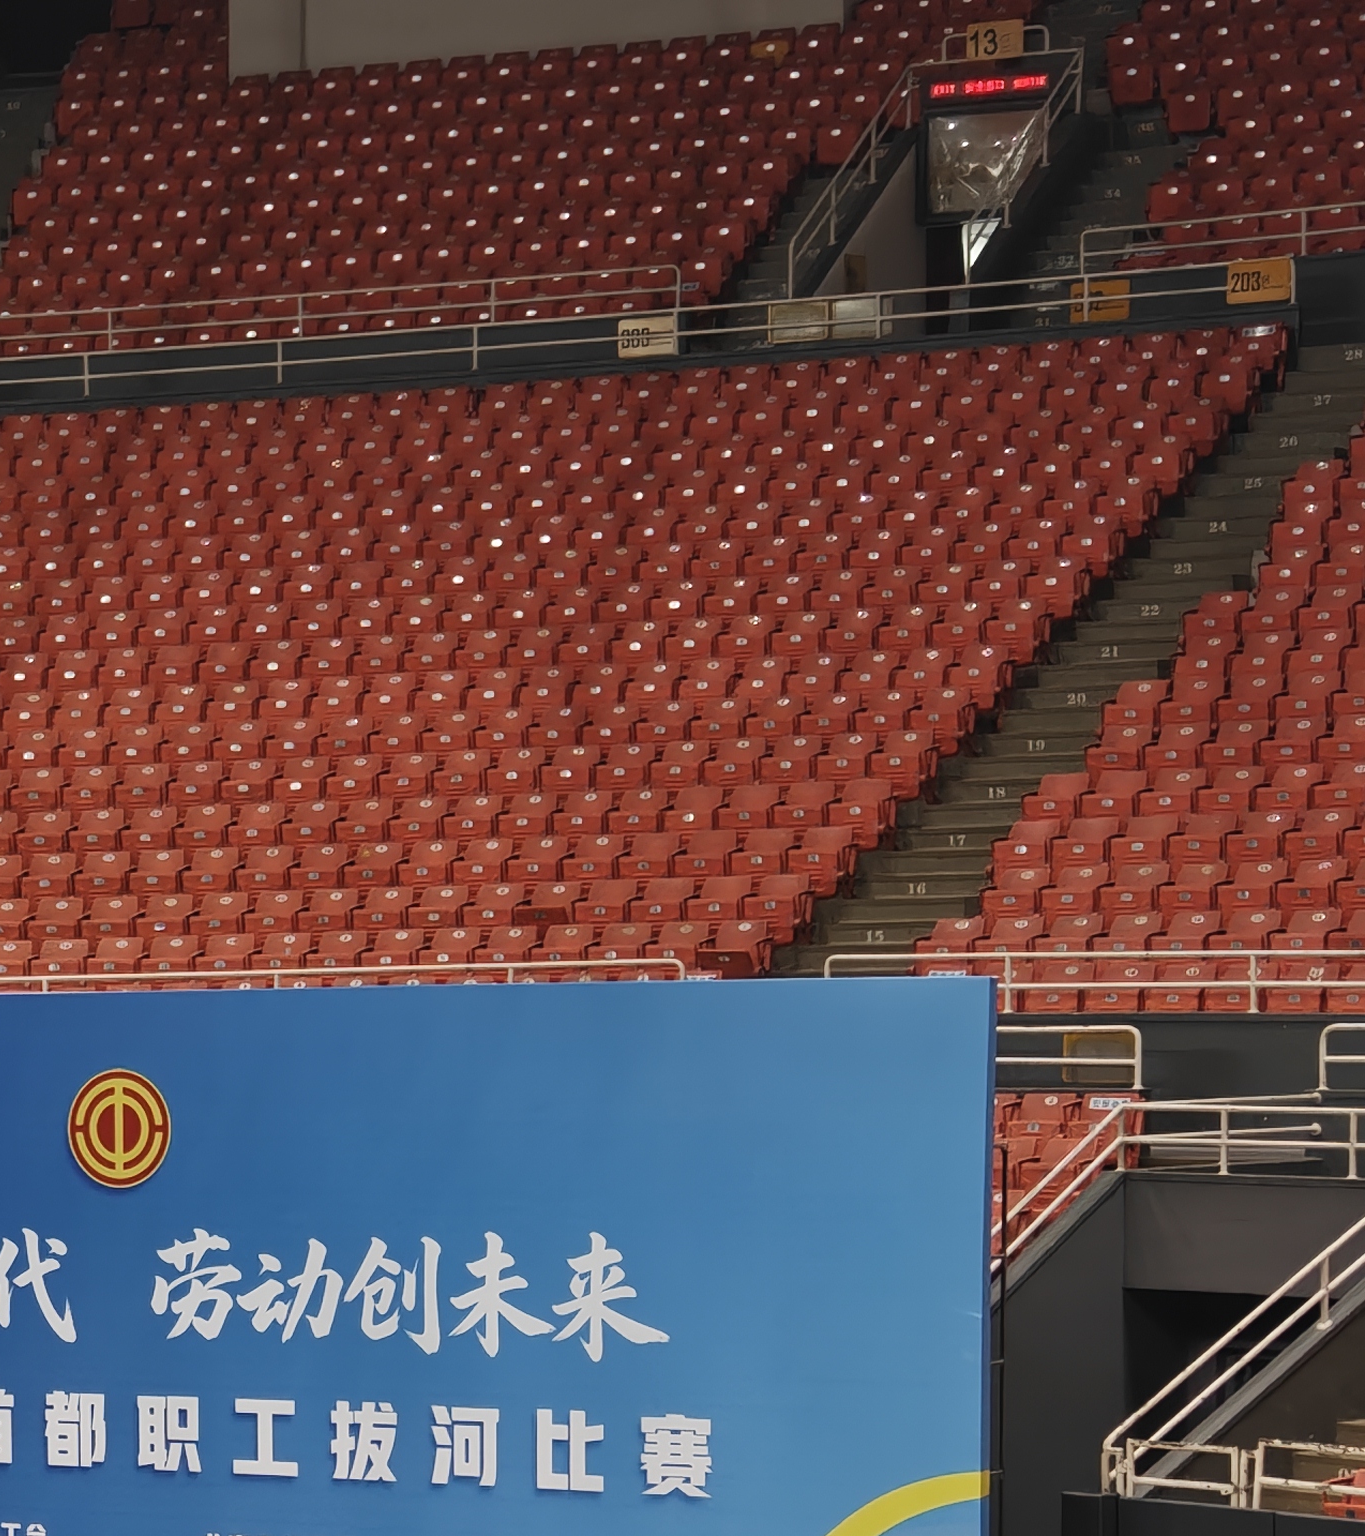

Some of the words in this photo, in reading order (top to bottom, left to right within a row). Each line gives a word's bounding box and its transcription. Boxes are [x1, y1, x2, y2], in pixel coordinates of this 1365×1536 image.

[969, 28, 999, 57] 13
[1230, 272, 1261, 293] 203
[1344, 349, 1363, 361] 28
[1313, 394, 1332, 407] 27
[1279, 435, 1298, 448] 26
[1244, 477, 1262, 490] 25
[1208, 521, 1228, 533] 24
[1173, 562, 1193, 575] 23
[1141, 604, 1160, 617] 22
[1101, 646, 1119, 658] 21
[1067, 692, 1086, 705] 20
[1027, 739, 1046, 751] 19
[988, 786, 1007, 799] 18
[948, 834, 967, 847] 17
[908, 882, 927, 895] 16
[866, 930, 885, 943] 15
[152, 1227, 671, 1363] 劳动创未来
